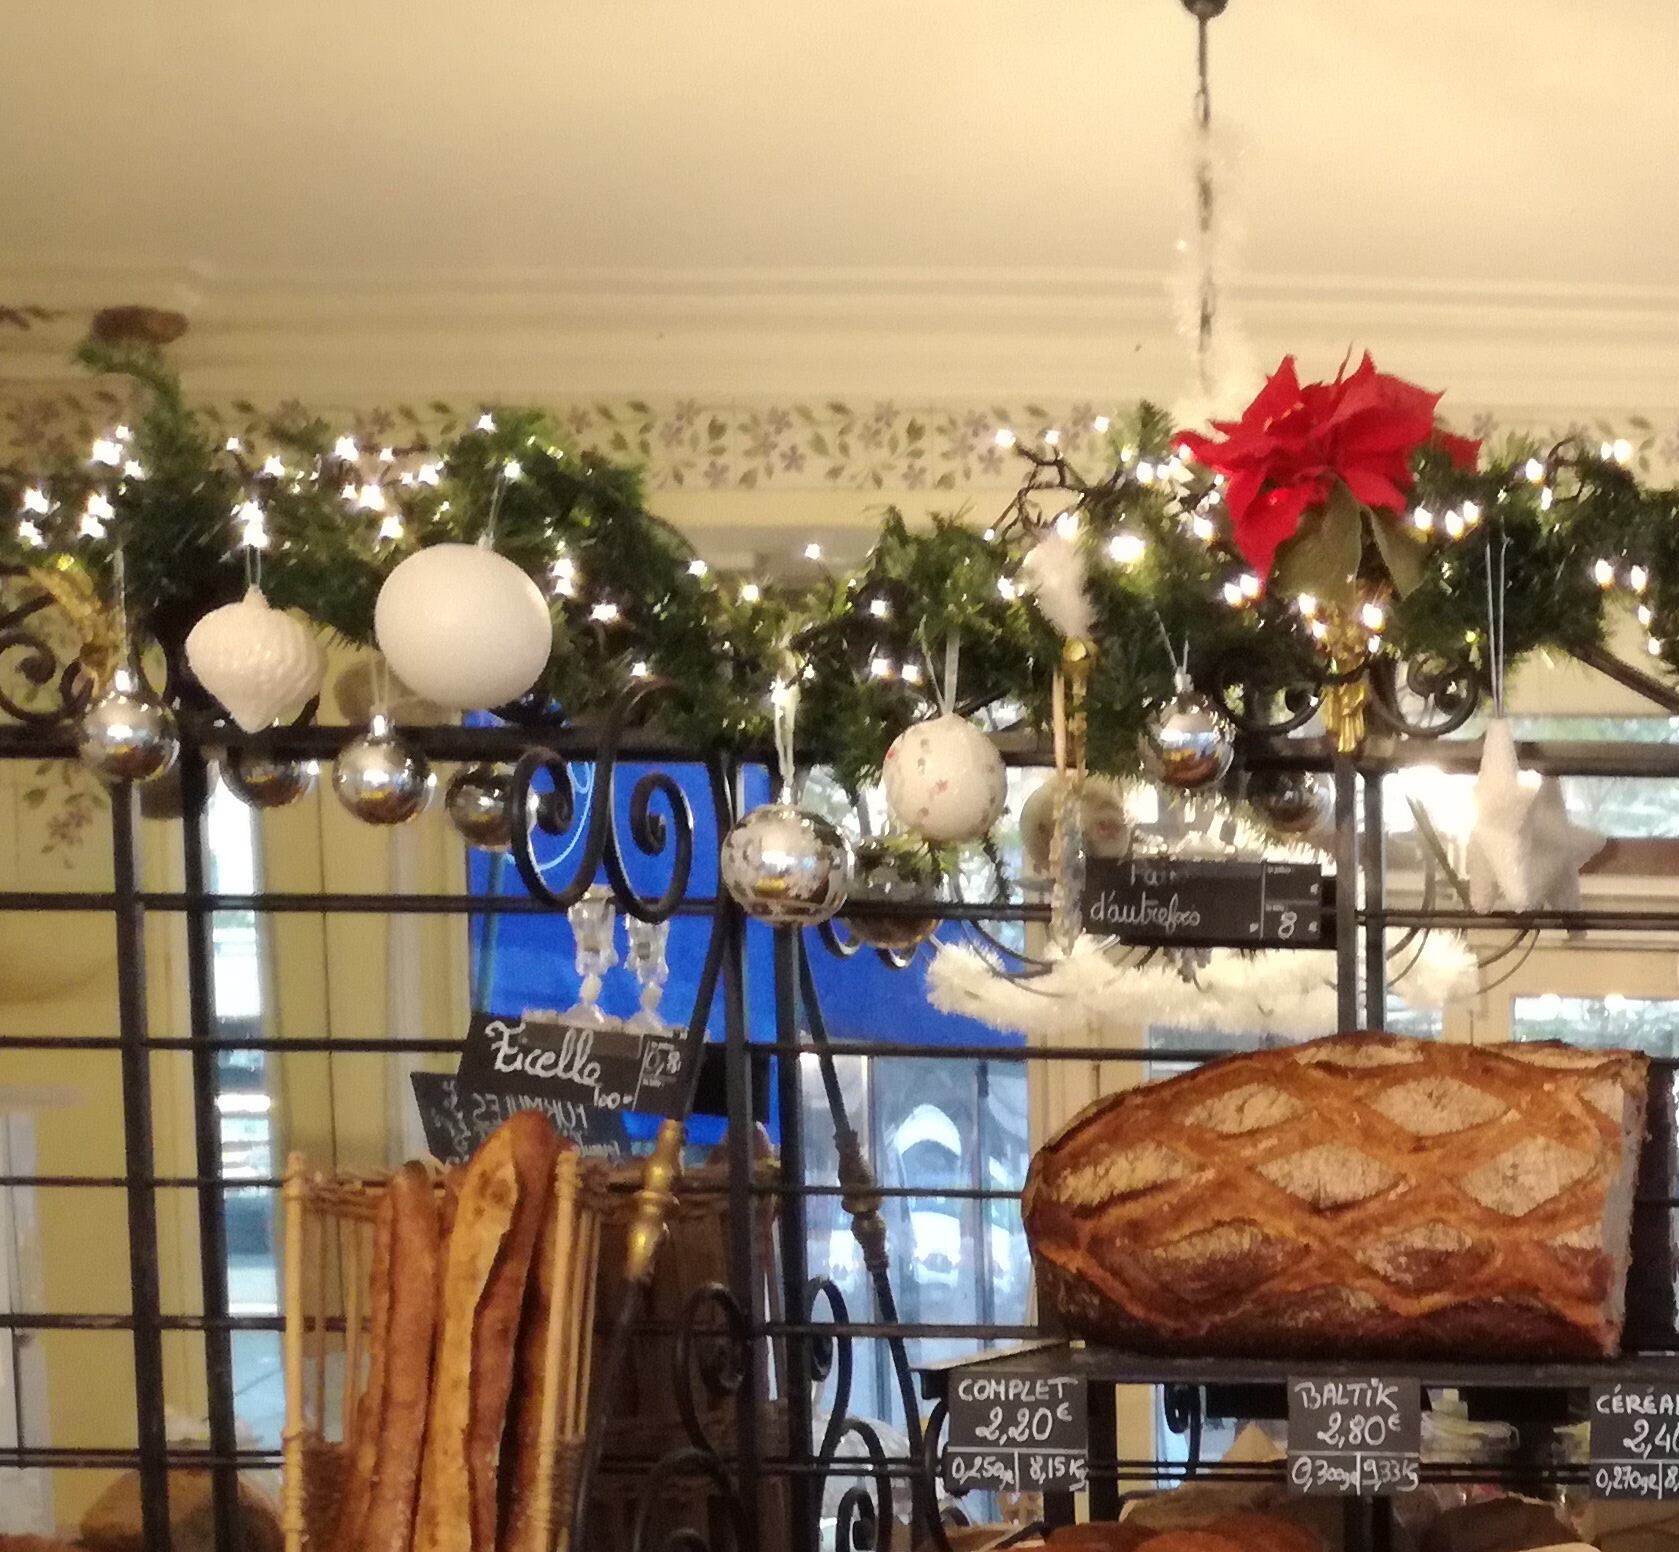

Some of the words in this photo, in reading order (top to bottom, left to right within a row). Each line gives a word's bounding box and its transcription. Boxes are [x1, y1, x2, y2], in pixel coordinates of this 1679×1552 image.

[484, 1020, 602, 1087] Ficelle
[958, 1376, 1079, 1402] COMPLET
[1294, 1377, 1399, 1412] BALTIK
